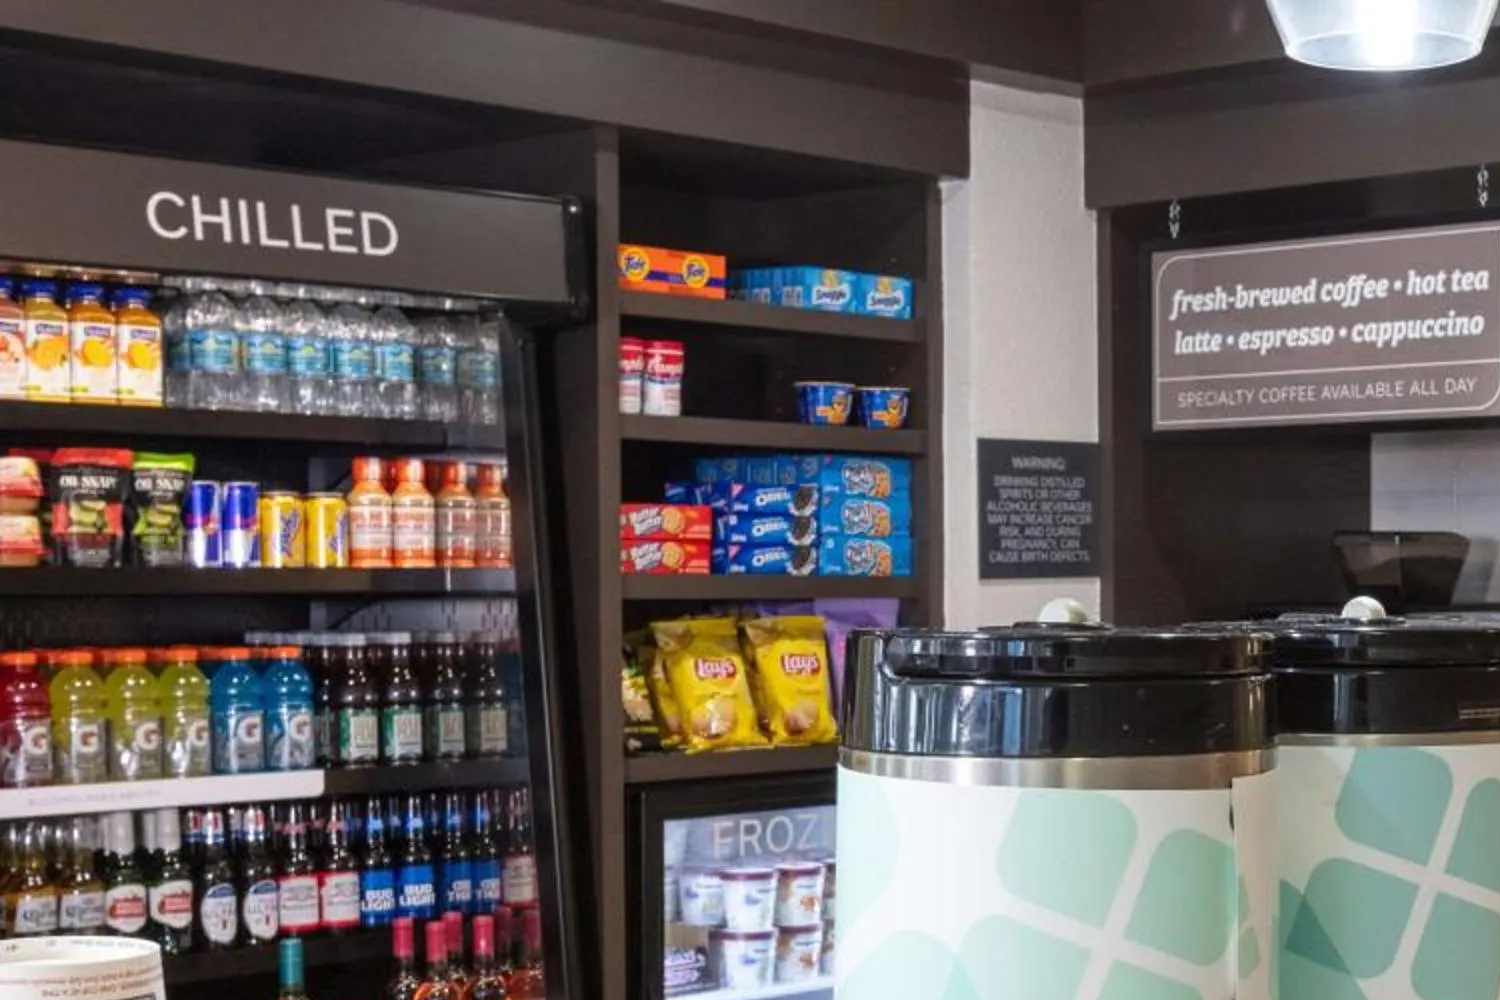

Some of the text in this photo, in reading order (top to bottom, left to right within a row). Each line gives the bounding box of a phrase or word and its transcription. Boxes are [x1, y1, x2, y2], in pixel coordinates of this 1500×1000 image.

[146, 190, 399, 257] CHILLED
[1168, 267, 1490, 321] fresh-brewed coffee hot tea
[1173, 309, 1485, 356] latte espresso cappuccino
[1177, 376, 1478, 409] SPECIALTY COFFEE AVAILABLE ALL DAY
[992, 475, 1086, 488] DRINKING DISTILLED
[1034, 488, 1049, 499] OR
[1051, 488, 1082, 500] OTHER
[986, 500, 1093, 513] ALCOHOLIC BEVERAGES
[987, 513, 1092, 525] MAY INCREASE CANCER
[1045, 526, 1081, 538] DURING
[1060, 538, 1081, 549] CAN
[988, 550, 1020, 563] CAUSE
[1021, 550, 1048, 562] BIRTH
[189, 719, 209, 747] G
[238, 715, 264, 744] G
[290, 713, 312, 741] G
[24, 726, 48, 755] G
[79, 724, 99, 752] G
[135, 721, 161, 751] G
[365, 888, 394, 901] BUD
[404, 883, 433, 896] BUD
[361, 899, 396, 912] LIGHT
[399, 893, 436, 907] LIGHT
